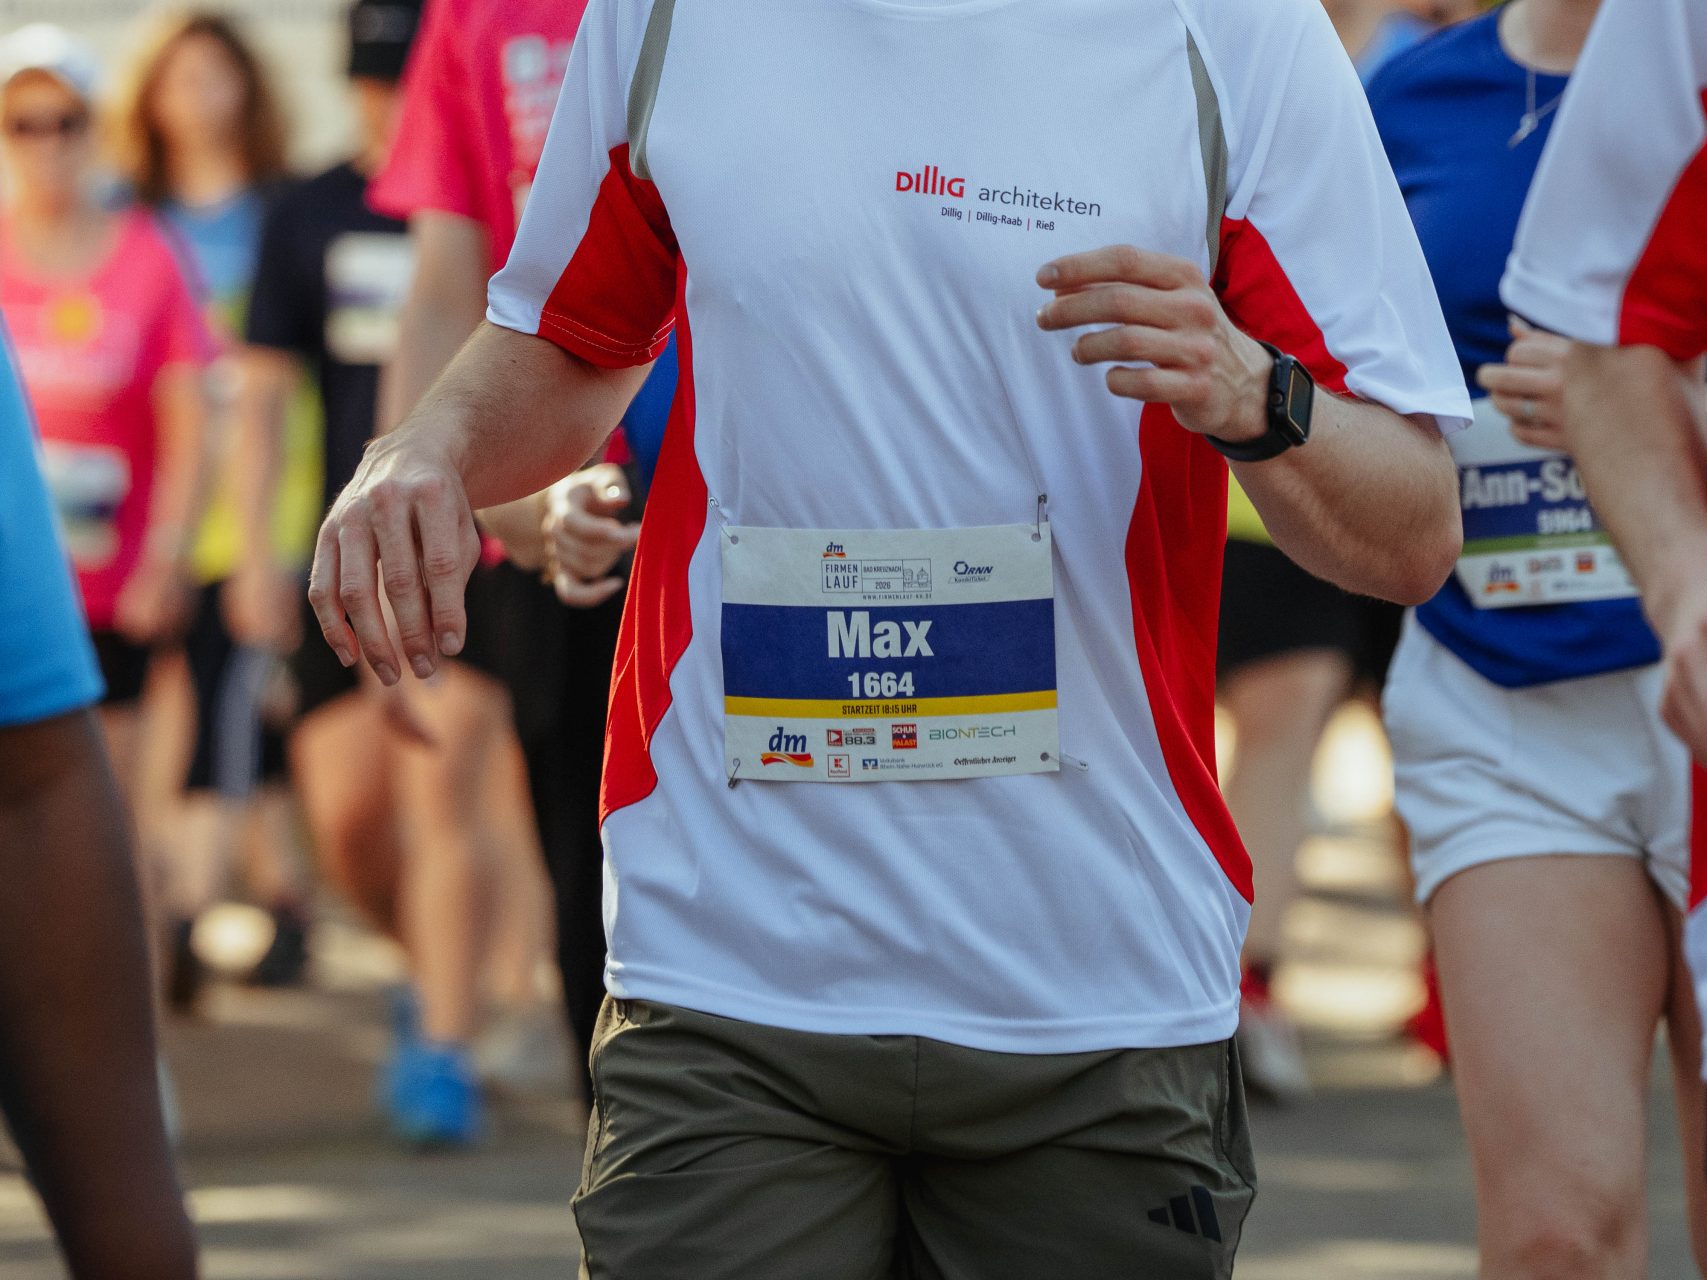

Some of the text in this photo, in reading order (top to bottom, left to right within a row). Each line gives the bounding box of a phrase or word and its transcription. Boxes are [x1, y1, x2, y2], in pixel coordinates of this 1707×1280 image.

[978, 186, 1102, 217] architekten
[941, 206, 1055, 231] Dillig Dillig-Raab Rieß
[826, 542, 844, 553] dm
[825, 564, 859, 574] FIRMEN
[874, 565, 902, 573] KREUZNACH
[826, 575, 859, 589] LAUF
[827, 610, 935, 658] Max
[847, 671, 915, 698] 1664
[842, 703, 918, 715] STARTZEIT 18:15 UHR
[892, 725, 916, 734] SCHUH
[929, 725, 1016, 741] BIONTECH
[768, 726, 807, 753] dm
[845, 736, 876, 746] 88.3
